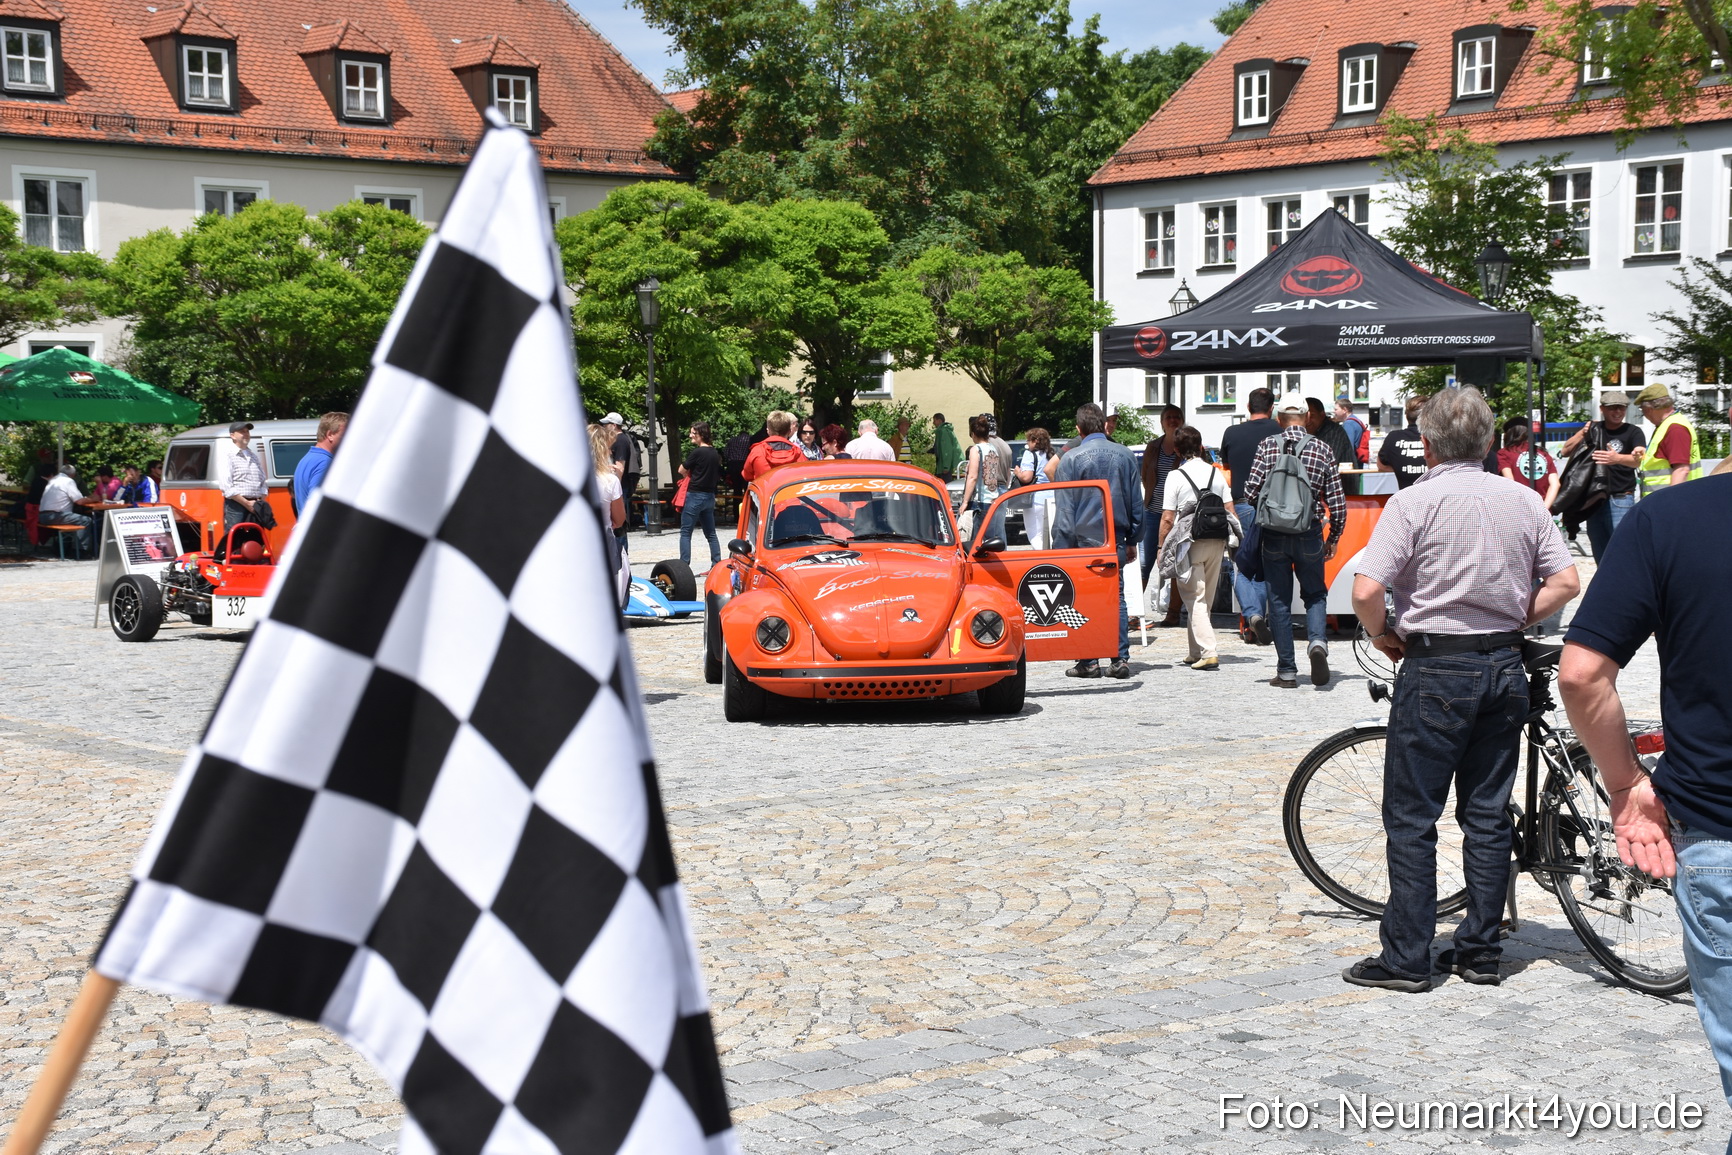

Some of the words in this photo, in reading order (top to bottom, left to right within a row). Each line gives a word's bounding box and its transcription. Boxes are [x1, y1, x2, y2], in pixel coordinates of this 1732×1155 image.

[1252, 299, 1379, 313] 24MX
[1171, 327, 1289, 351] 24MX
[1339, 324, 1386, 336] 24MX.DE
[1337, 336, 1400, 346] DEUTSCHLANDS
[1401, 334, 1444, 345] GRÖSSTER
[1444, 335, 1471, 344] CROSS
[1472, 335, 1496, 344] SHOP
[796, 481, 865, 495] Boxer
[868, 479, 917, 492] Shop
[813, 565, 888, 601] Boxer
[889, 570, 949, 580] Shop
[227, 596, 246, 616] 332
[1028, 583, 1064, 617] FV
